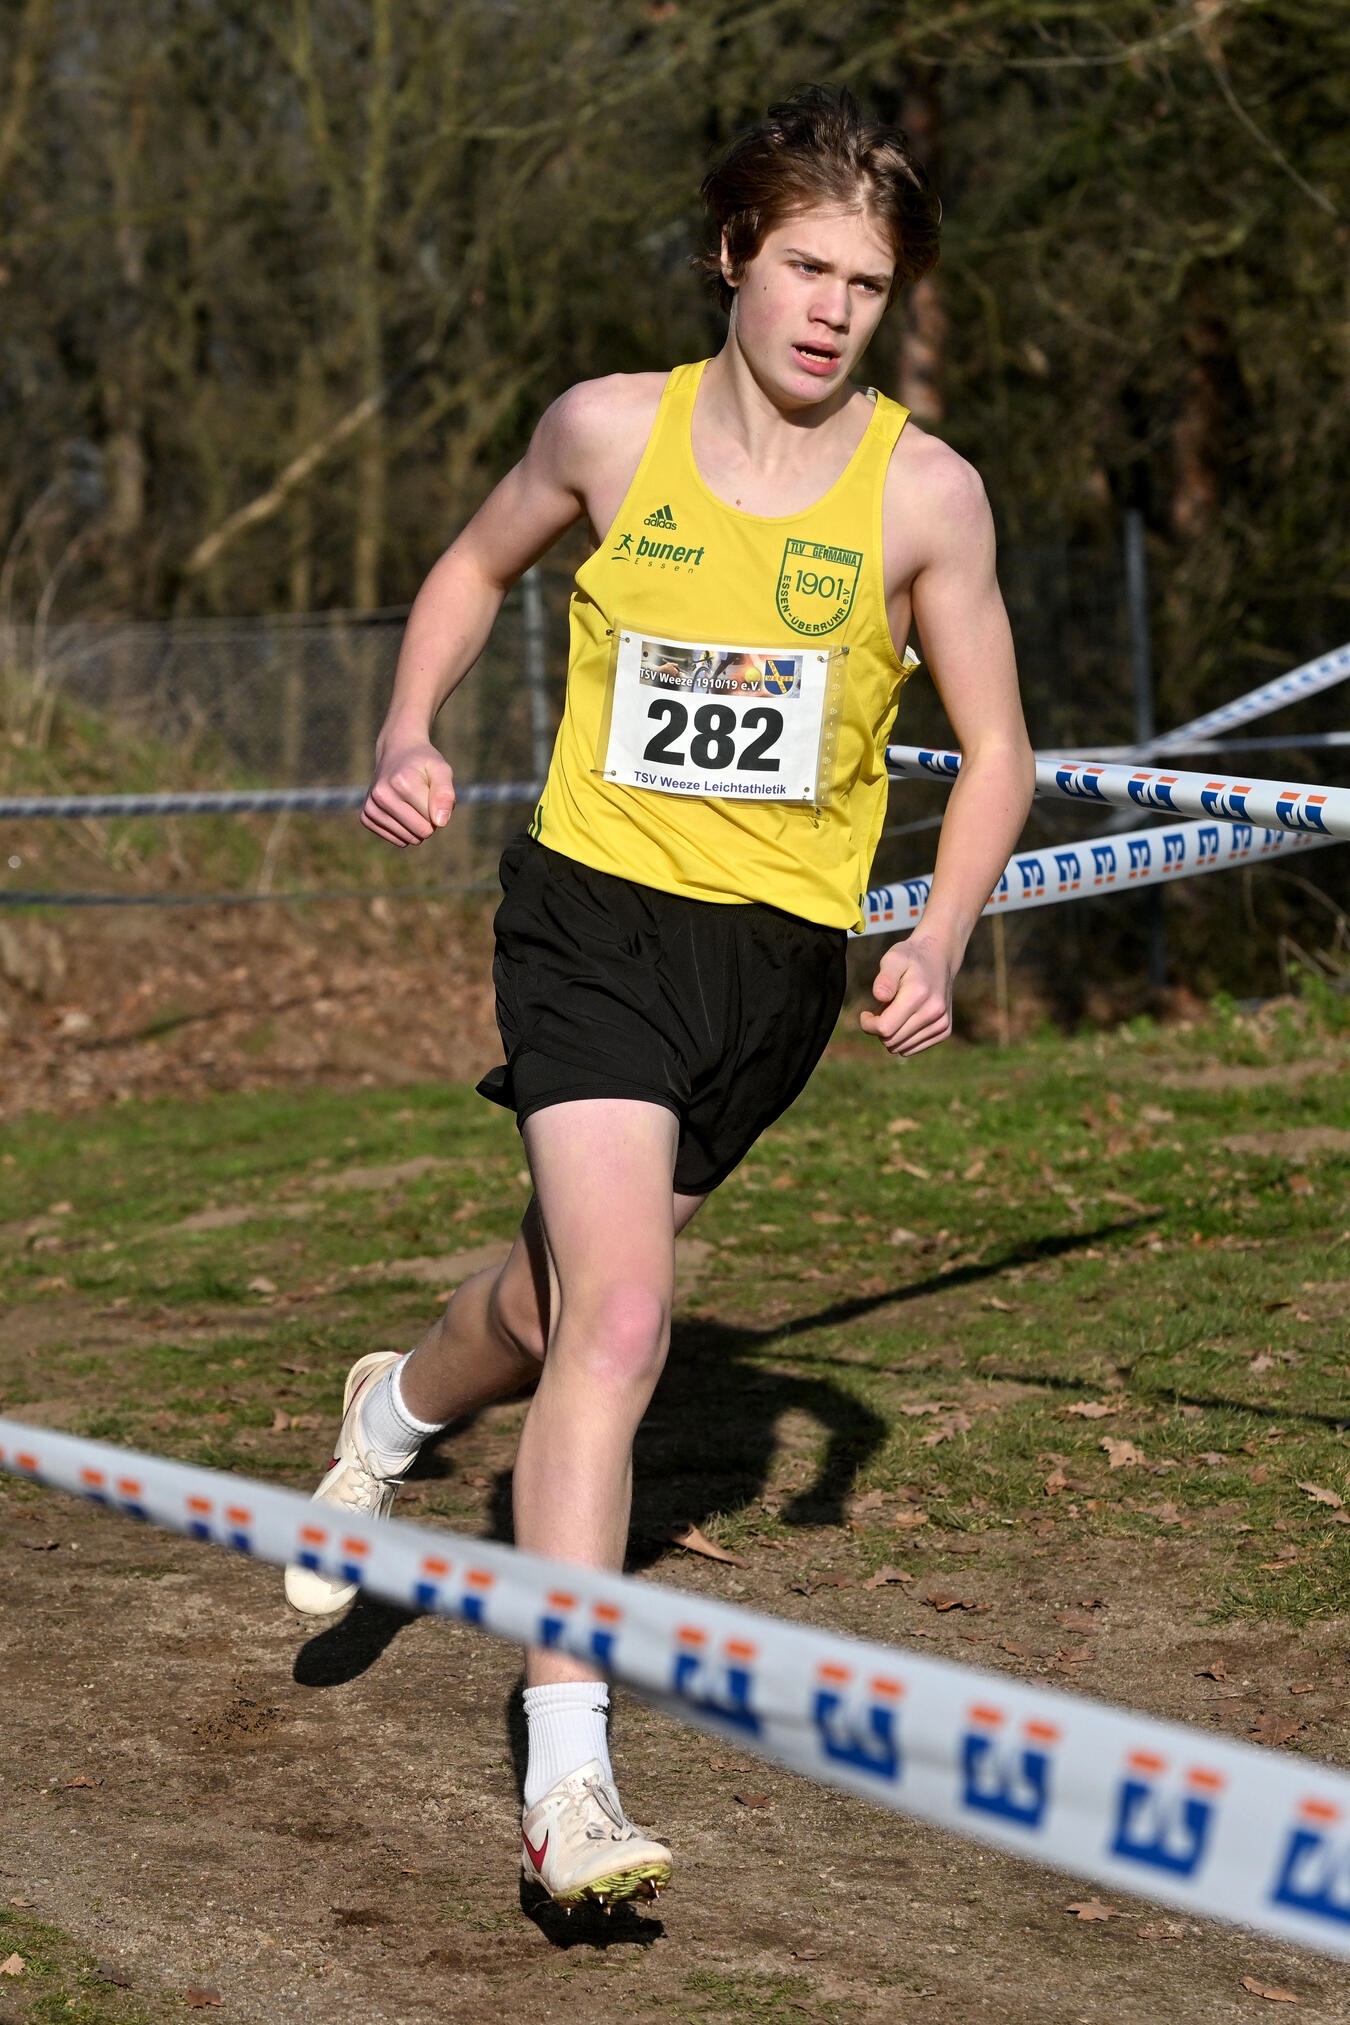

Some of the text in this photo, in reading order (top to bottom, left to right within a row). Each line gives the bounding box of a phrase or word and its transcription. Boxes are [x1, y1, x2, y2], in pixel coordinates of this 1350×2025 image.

[644, 516, 677, 531] adidas
[635, 536, 705, 566] bunert
[791, 543, 857, 566] TLV GERMANIA
[795, 570, 844, 601] 1901
[639, 668, 761, 692] TSV Weeze 1910/19 e.V.
[643, 698, 784, 772] 282
[634, 771, 786, 795] TSV Weeze Leichtathletik
